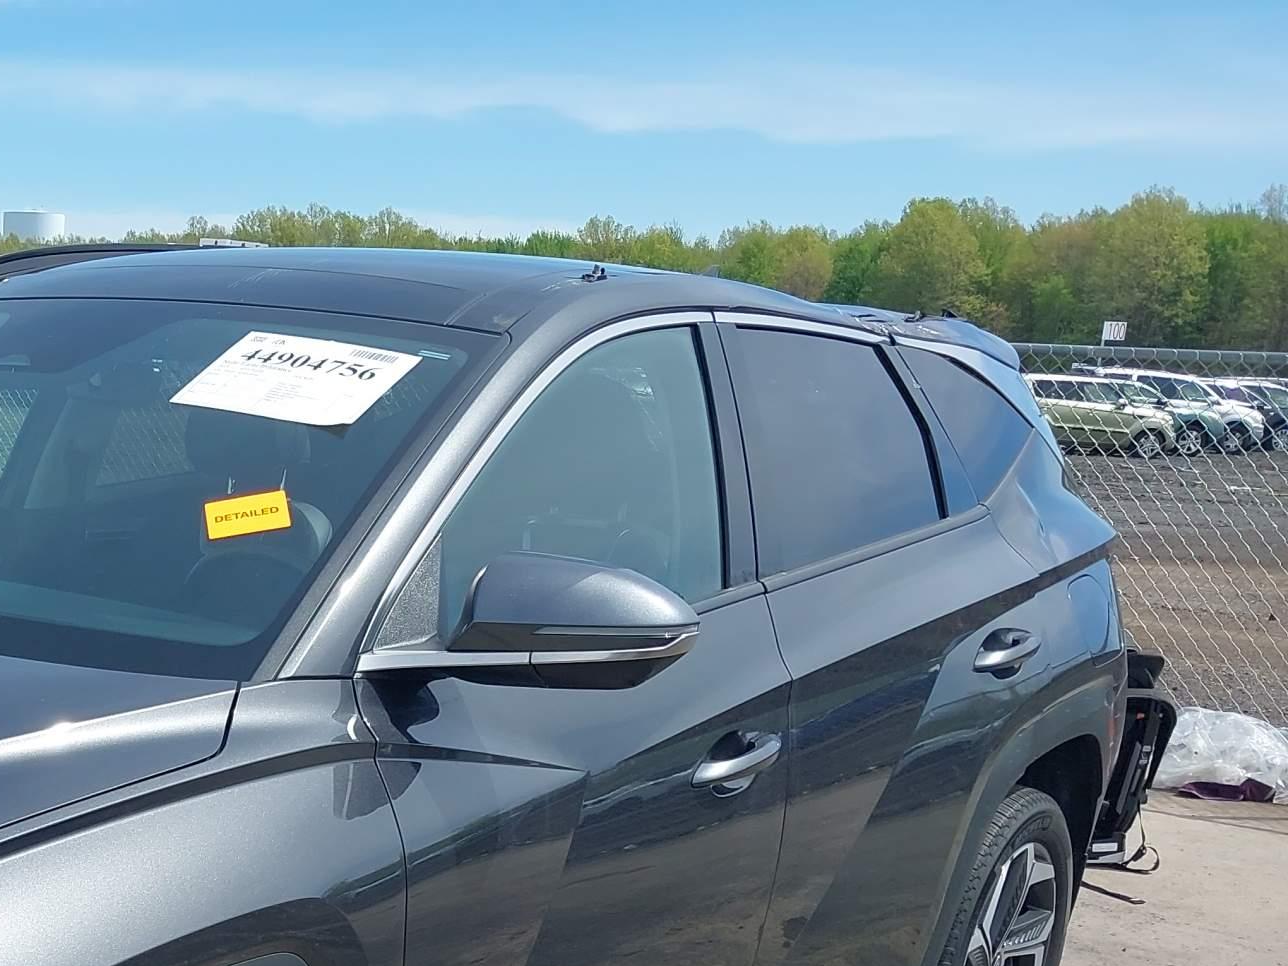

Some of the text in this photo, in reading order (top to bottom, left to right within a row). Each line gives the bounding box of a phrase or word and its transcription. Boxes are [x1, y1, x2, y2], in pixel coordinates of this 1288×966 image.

[1108, 322, 1126, 340] 100
[240, 348, 381, 381] 44904756
[214, 506, 279, 524] DETAILED
